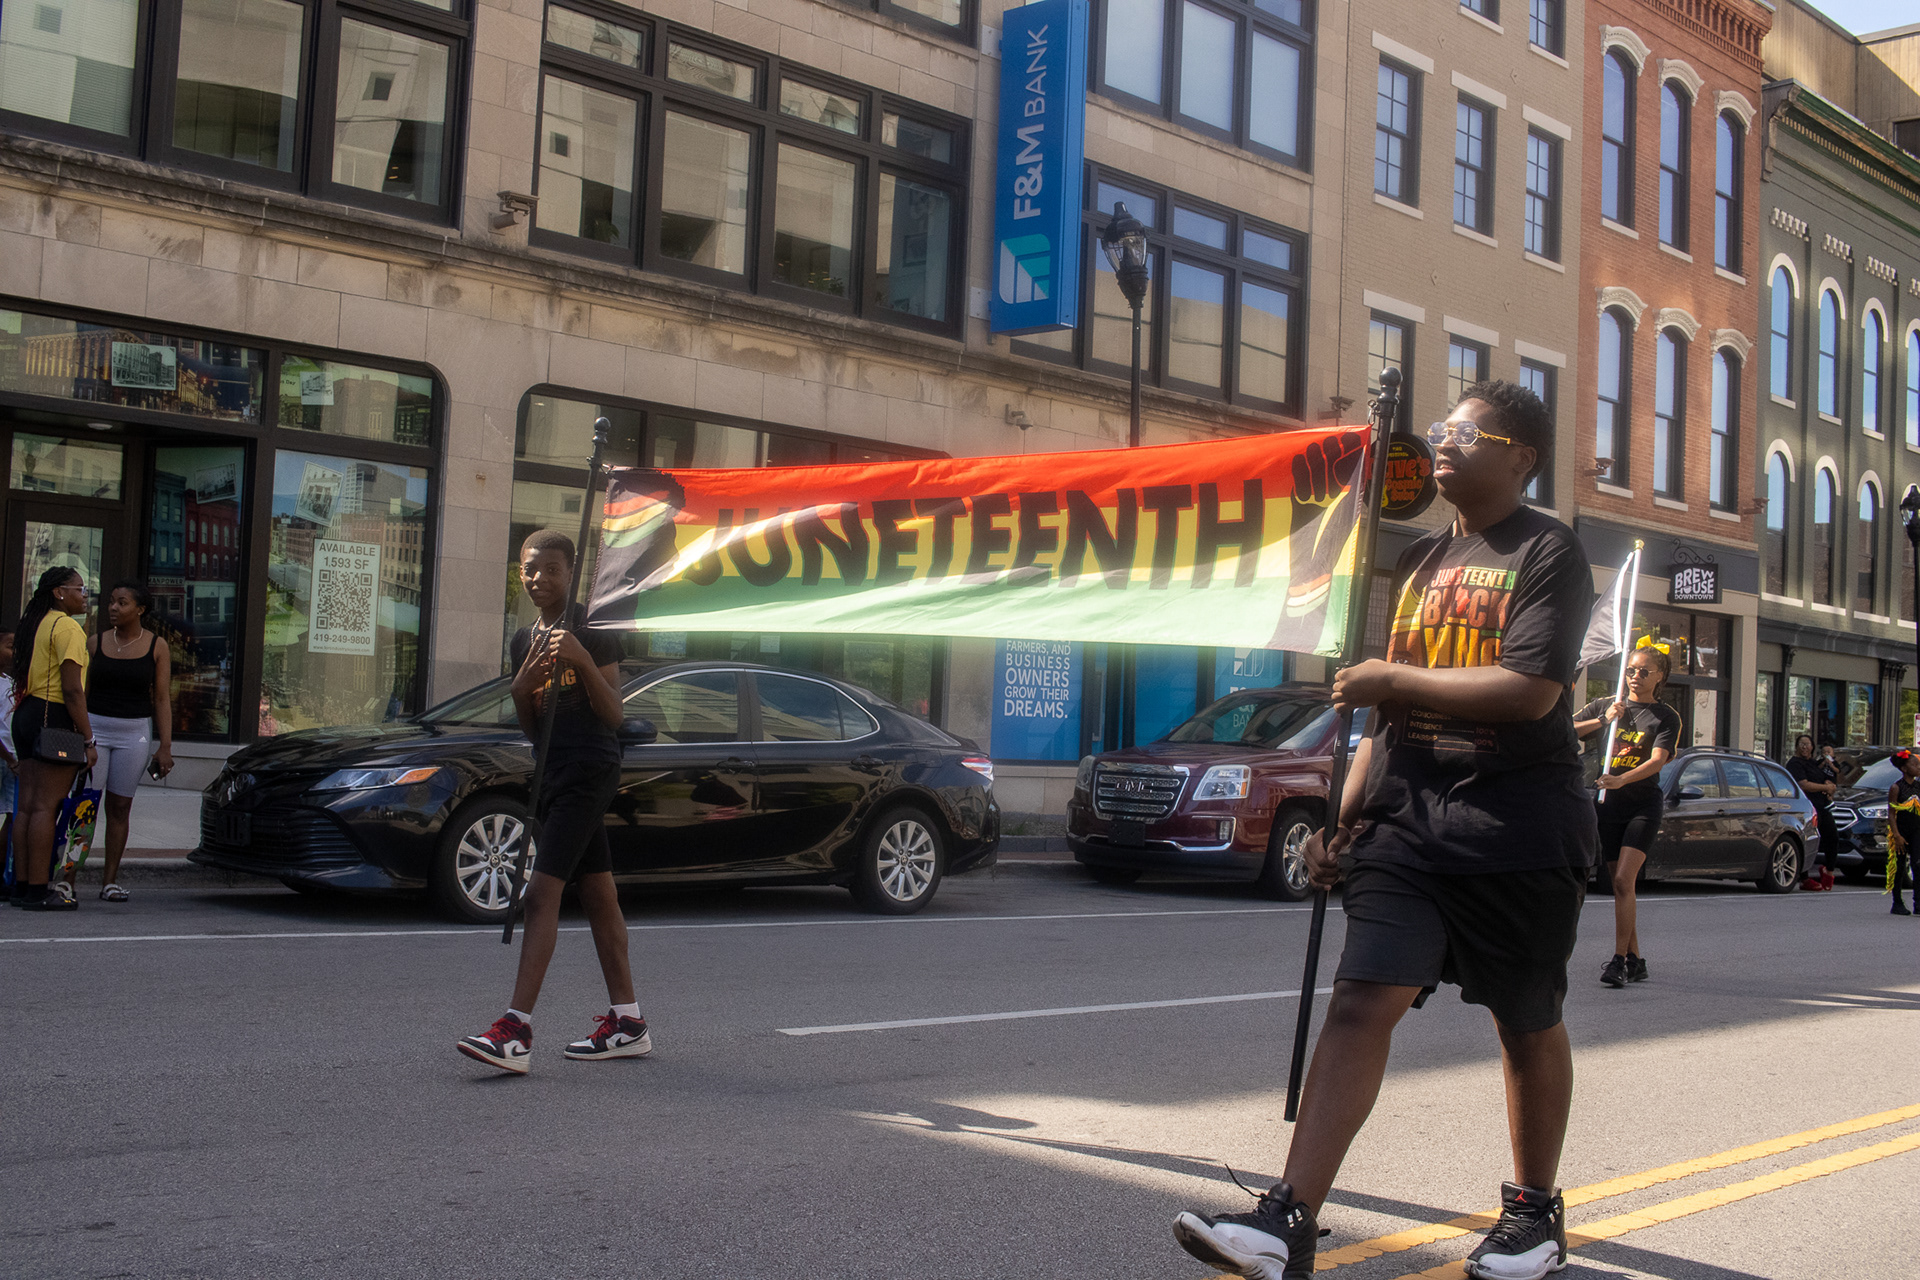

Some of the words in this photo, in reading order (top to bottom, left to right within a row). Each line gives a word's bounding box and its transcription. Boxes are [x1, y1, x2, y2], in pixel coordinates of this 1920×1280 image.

[1024, 24, 1049, 117] BANK
[1013, 123, 1044, 220] F&M
[1368, 456, 1431, 479] ave's
[682, 478, 1263, 590] JUNETEENTH
[319, 542, 376, 557] AVAILABLE
[354, 558, 369, 570] SF
[1675, 567, 1714, 589] BREW
[1675, 578, 1714, 594] HOUSE
[313, 633, 371, 645] 419-249-9800
[1006, 640, 1049, 656] FARMERS,
[1051, 644, 1071, 655] AND
[1005, 653, 1071, 670] BUSINESS
[1005, 667, 1070, 687] OWNERS
[1004, 685, 1037, 699] GROW
[1040, 687, 1069, 700] THEIR
[1004, 699, 1068, 719] DREAMS.
[1116, 780, 1154, 793] GMC
